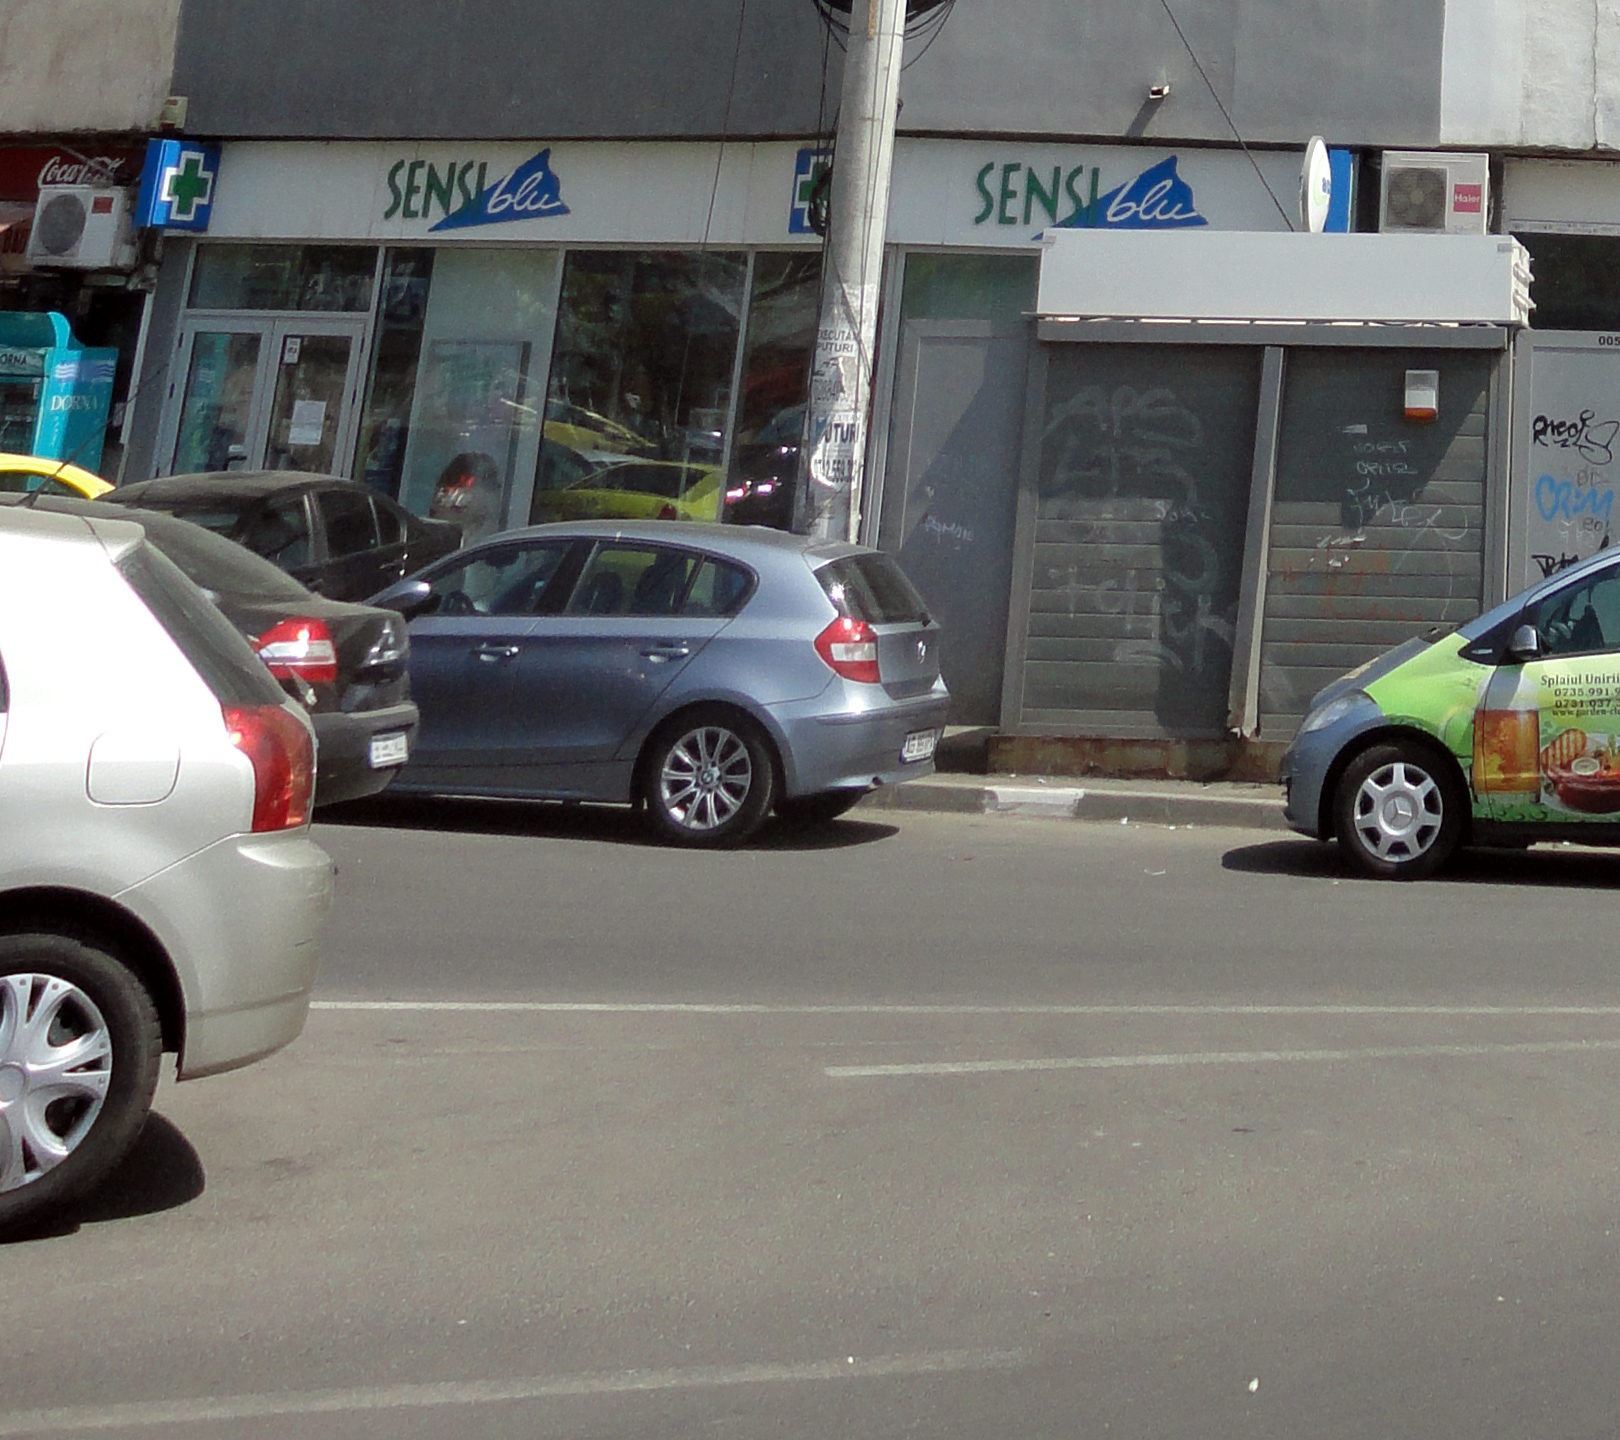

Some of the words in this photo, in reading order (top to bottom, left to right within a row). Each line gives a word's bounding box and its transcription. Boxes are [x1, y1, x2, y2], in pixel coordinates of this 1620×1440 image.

[384, 159, 488, 220] SENSI
[487, 171, 562, 214] blu
[975, 162, 1100, 226] SENSI
[1106, 176, 1199, 223] blu
[1454, 193, 1480, 204] Haier
[1540, 673, 1582, 688] Splaiul
[1585, 672, 1620, 685] Unirii
